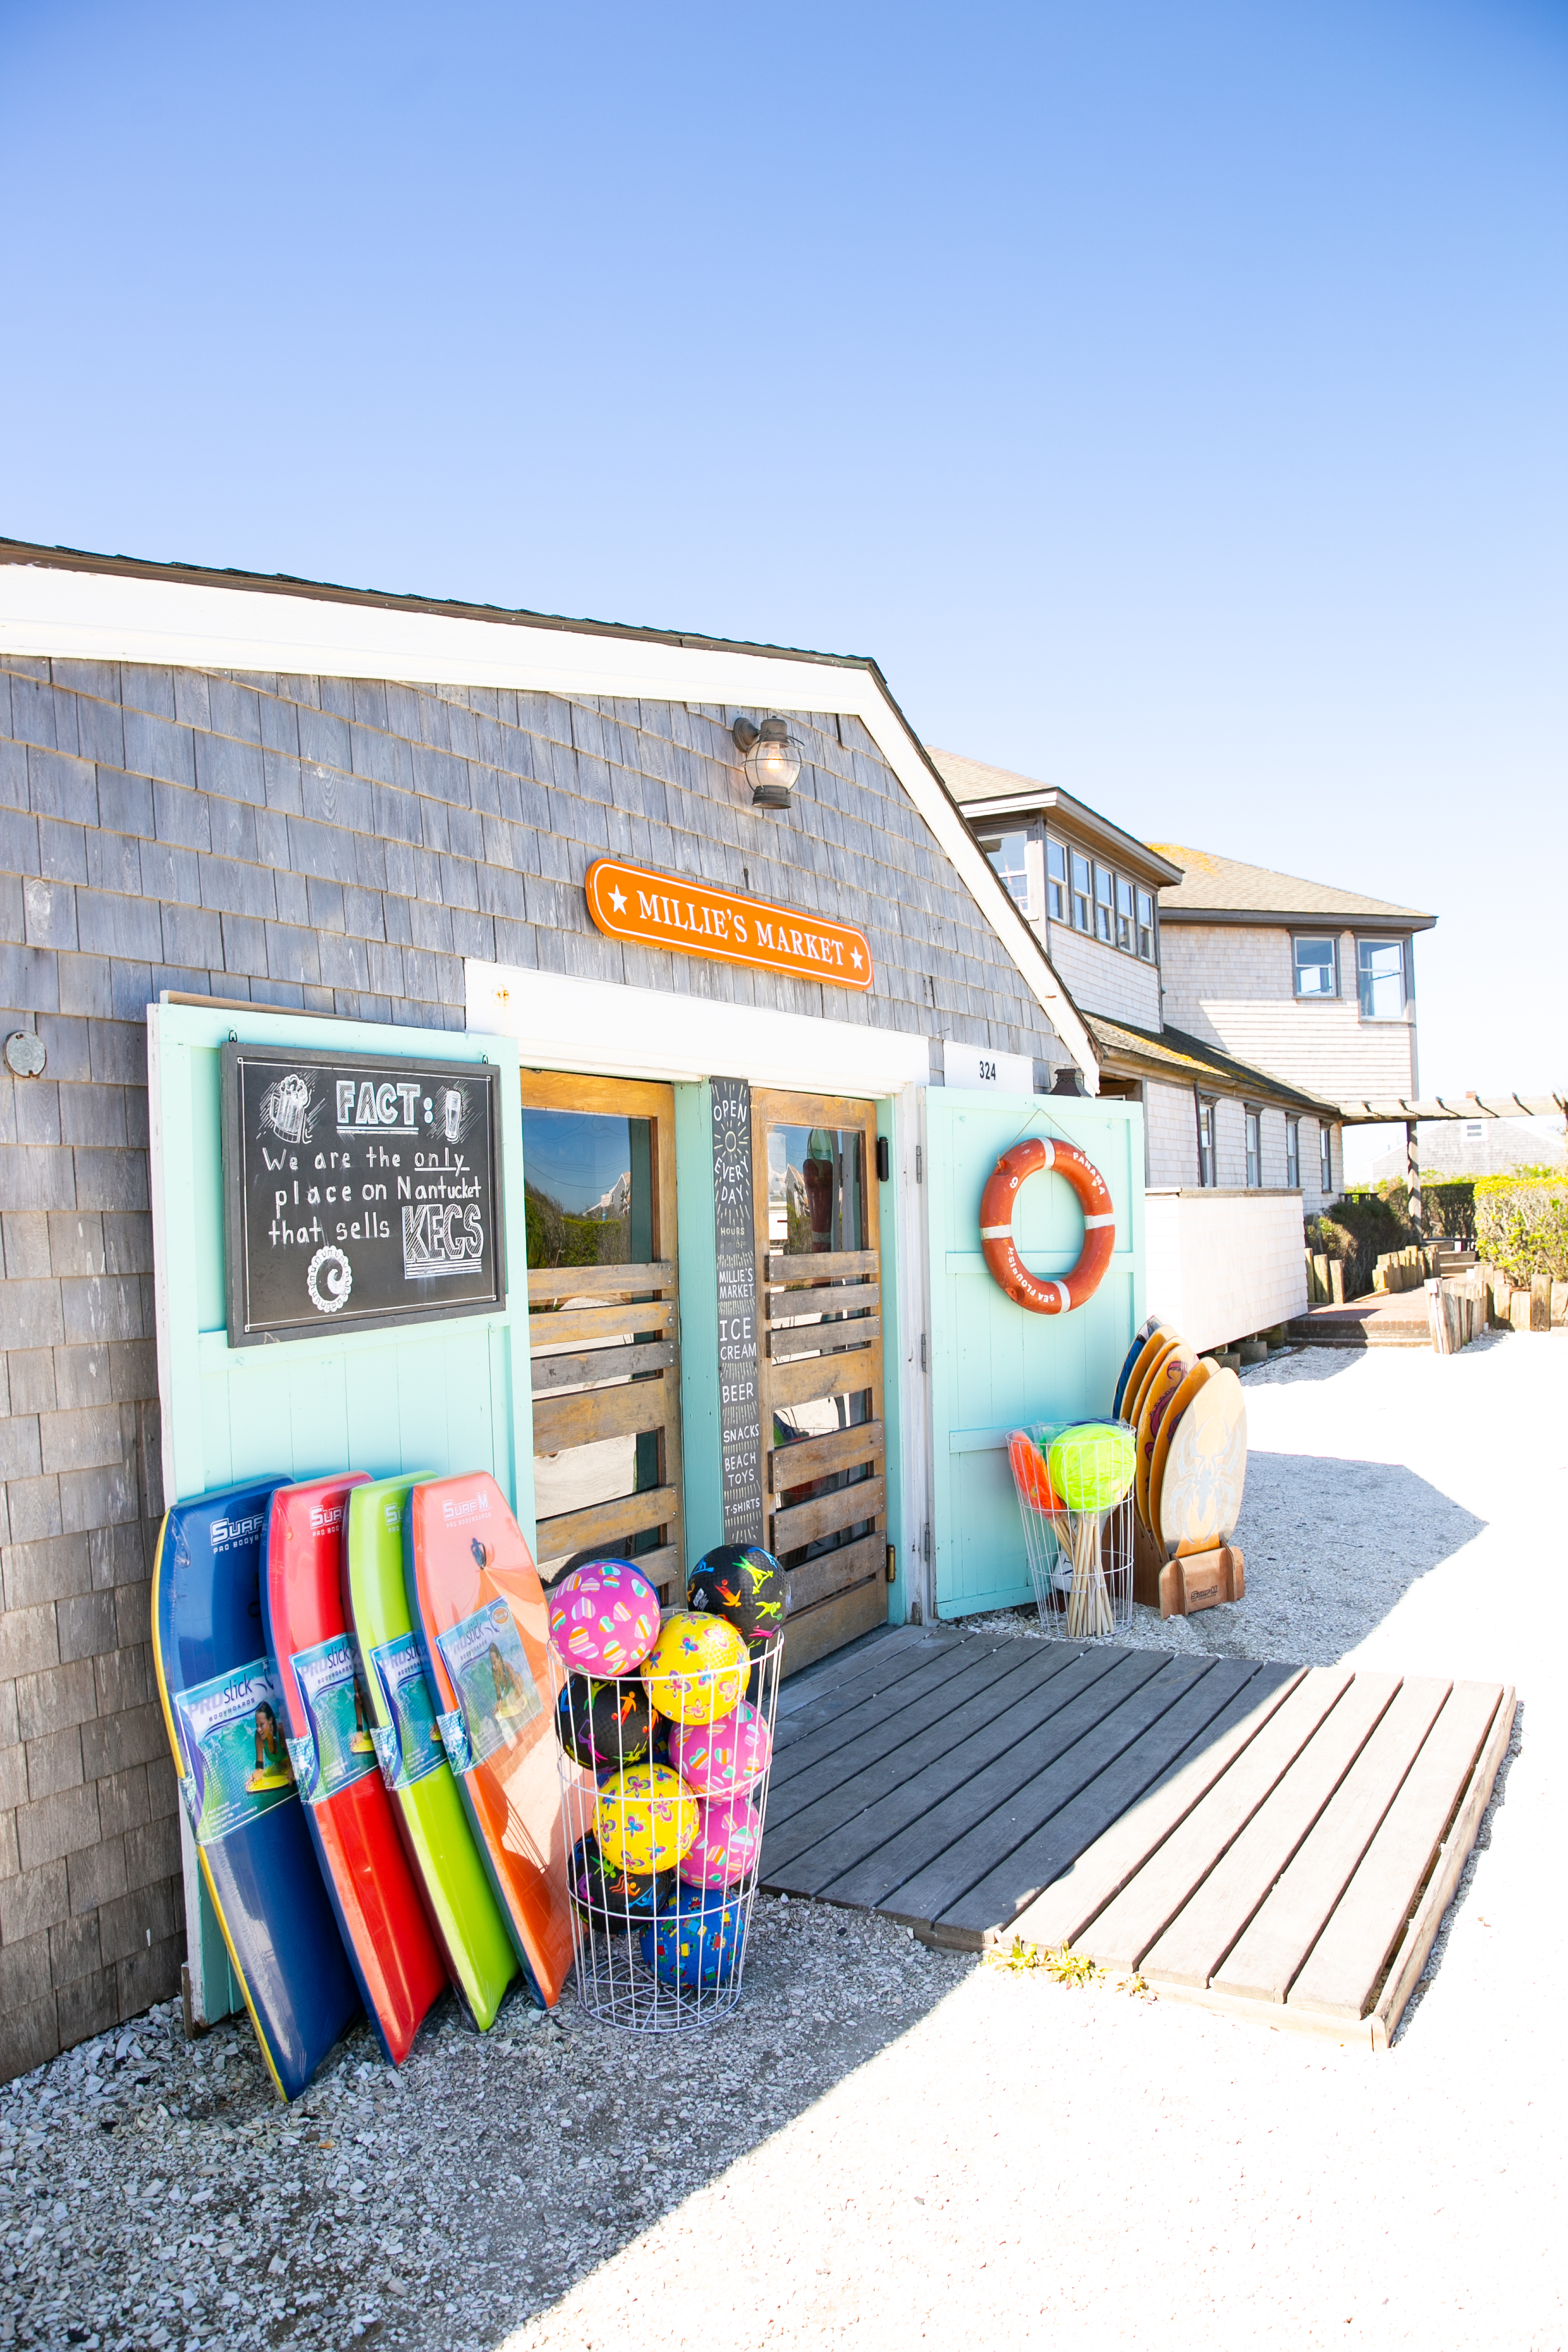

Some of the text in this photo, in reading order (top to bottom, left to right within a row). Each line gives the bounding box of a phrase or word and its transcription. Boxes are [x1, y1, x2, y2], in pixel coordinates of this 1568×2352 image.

[636, 890, 844, 966] MILLIE'S MARKET
[979, 1061, 996, 1080] 324
[336, 1080, 434, 1125] FACT:
[714, 1100, 747, 1122] OPEN
[262, 1146, 464, 1177] We are the only
[714, 1155, 748, 1183] EVERY
[1073, 1151, 1106, 1195] PANAMA
[275, 1175, 482, 1219] place on Nantucket
[721, 1184, 744, 1205] DAY
[268, 1203, 484, 1262] that sells KEGS
[720, 1226, 745, 1236] HOURS
[719, 1267, 753, 1283] MILLIE'S
[720, 1283, 754, 1299] MARKET
[1038, 1292, 1055, 1303] SEA
[720, 1317, 751, 1342] ICE
[720, 1342, 757, 1361] CREAM
[722, 1382, 754, 1404] BEER
[723, 1424, 760, 1443] SNACKS
[724, 1451, 756, 1472] BEACH
[728, 1468, 755, 1487] TOYS
[442, 1491, 490, 1521] SURF M
[309, 1505, 344, 1530] SUR
[458, 1512, 492, 1525] BODYBOARDS
[312, 1529, 325, 1537] PRO
[388, 1525, 400, 1534] PRO
[213, 1544, 230, 1554] PRO
[317, 1664, 352, 1684] BODYBOARDS
[209, 1698, 256, 1722] BODYBOARDS
